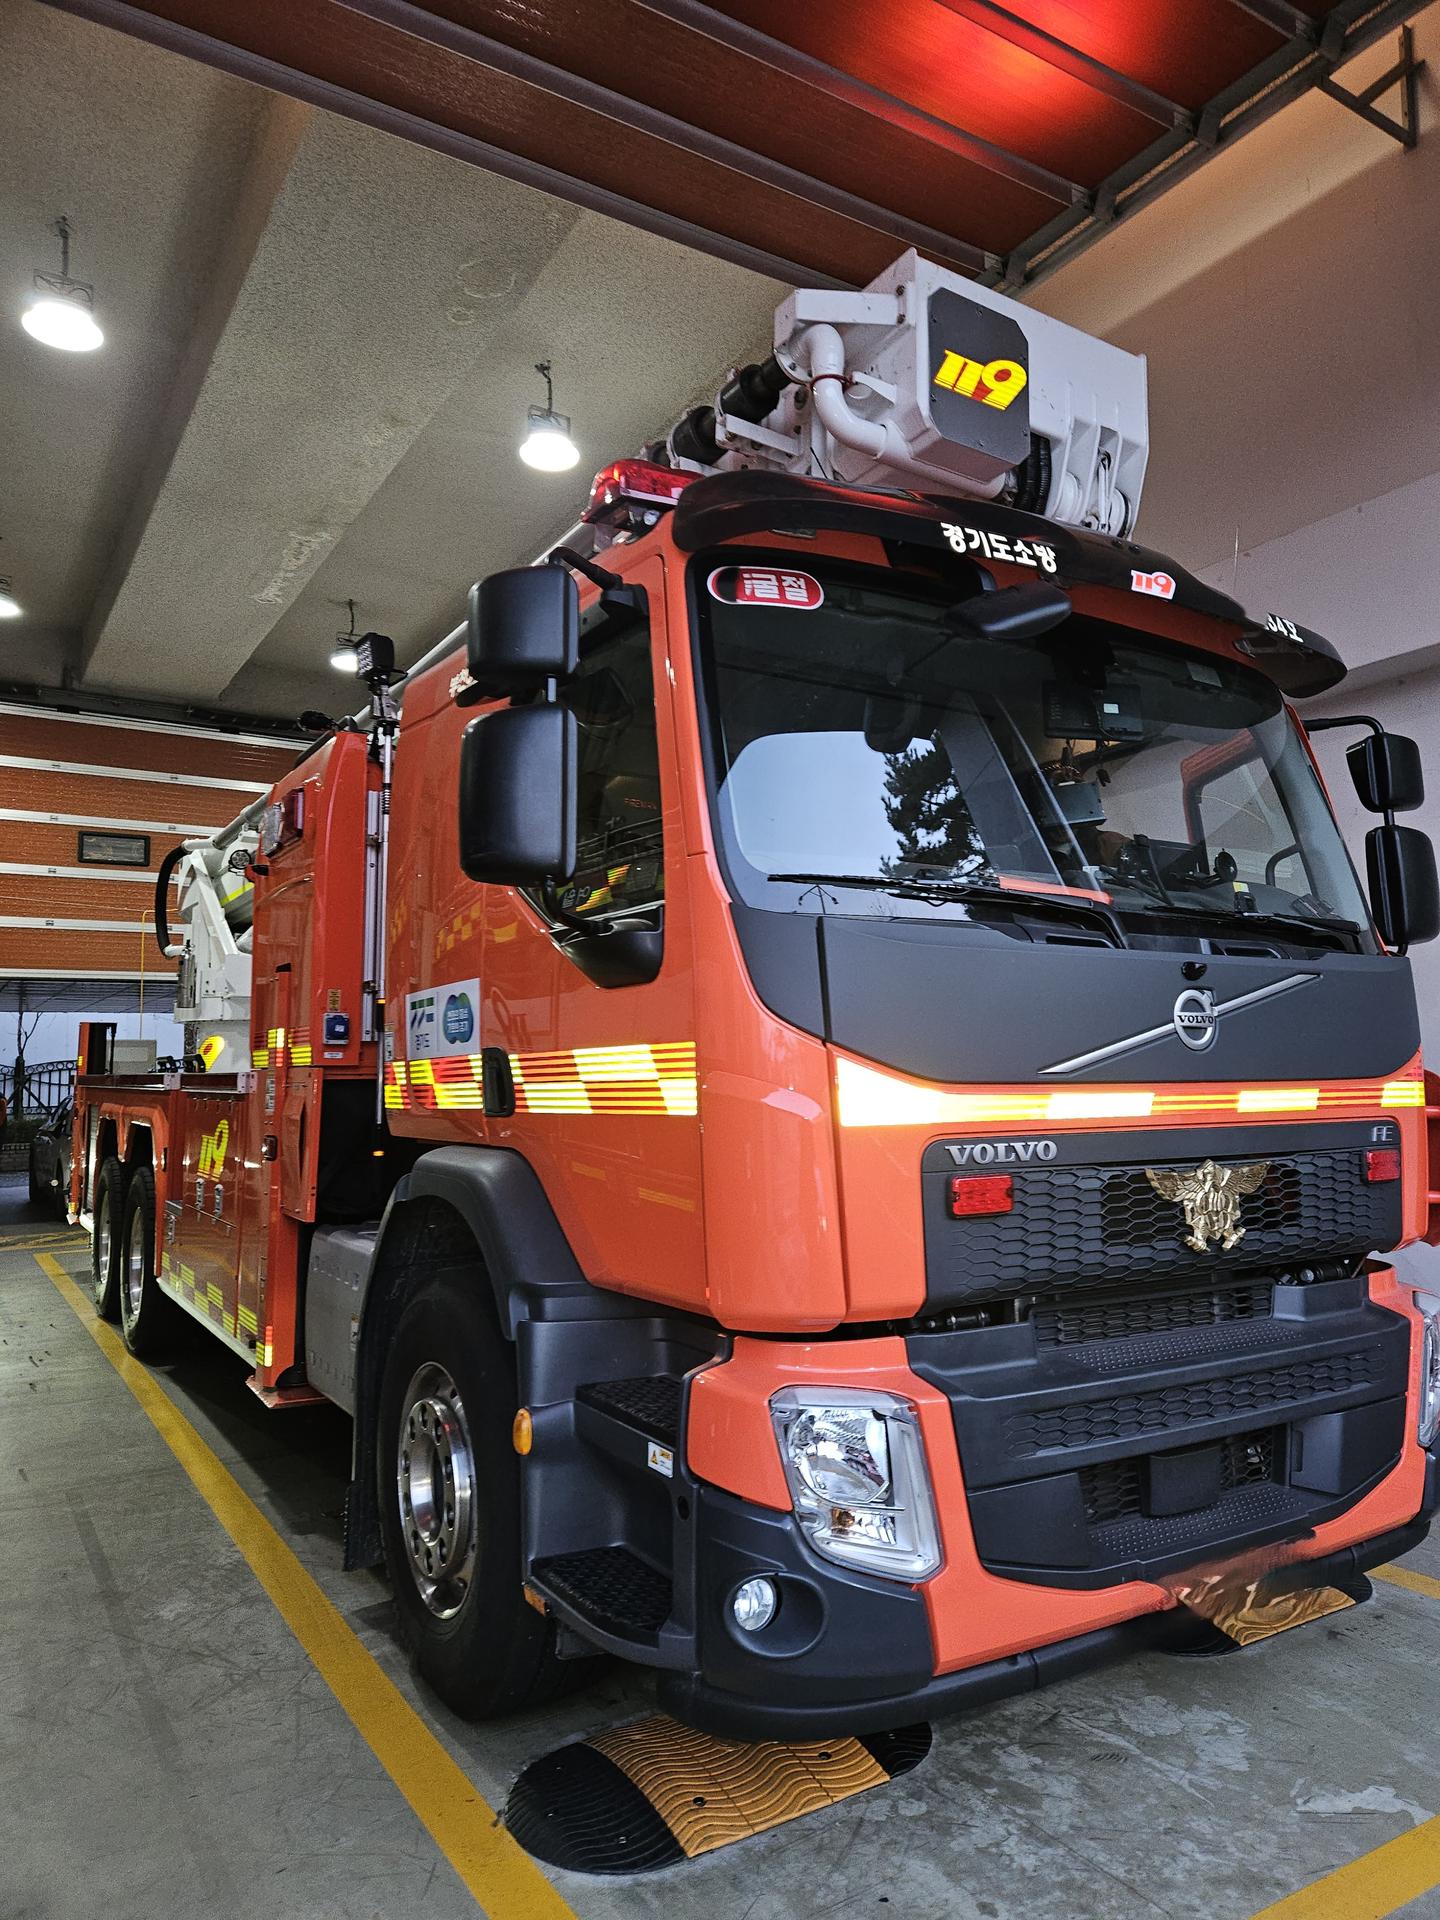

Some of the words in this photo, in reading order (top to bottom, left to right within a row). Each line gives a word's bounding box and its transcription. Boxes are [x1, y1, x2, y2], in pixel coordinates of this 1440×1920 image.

[934, 349, 1027, 411] 119
[940, 522, 1058, 573] 경기도소방
[742, 573, 809, 602] 굴절
[1132, 571, 1175, 598] 119
[1264, 612, 1304, 643] 34호
[1177, 1014, 1214, 1024] VOLVO
[1371, 1125, 1394, 1142] FE
[197, 1119, 229, 1182] 119
[944, 1140, 1058, 1165] VOLVO
